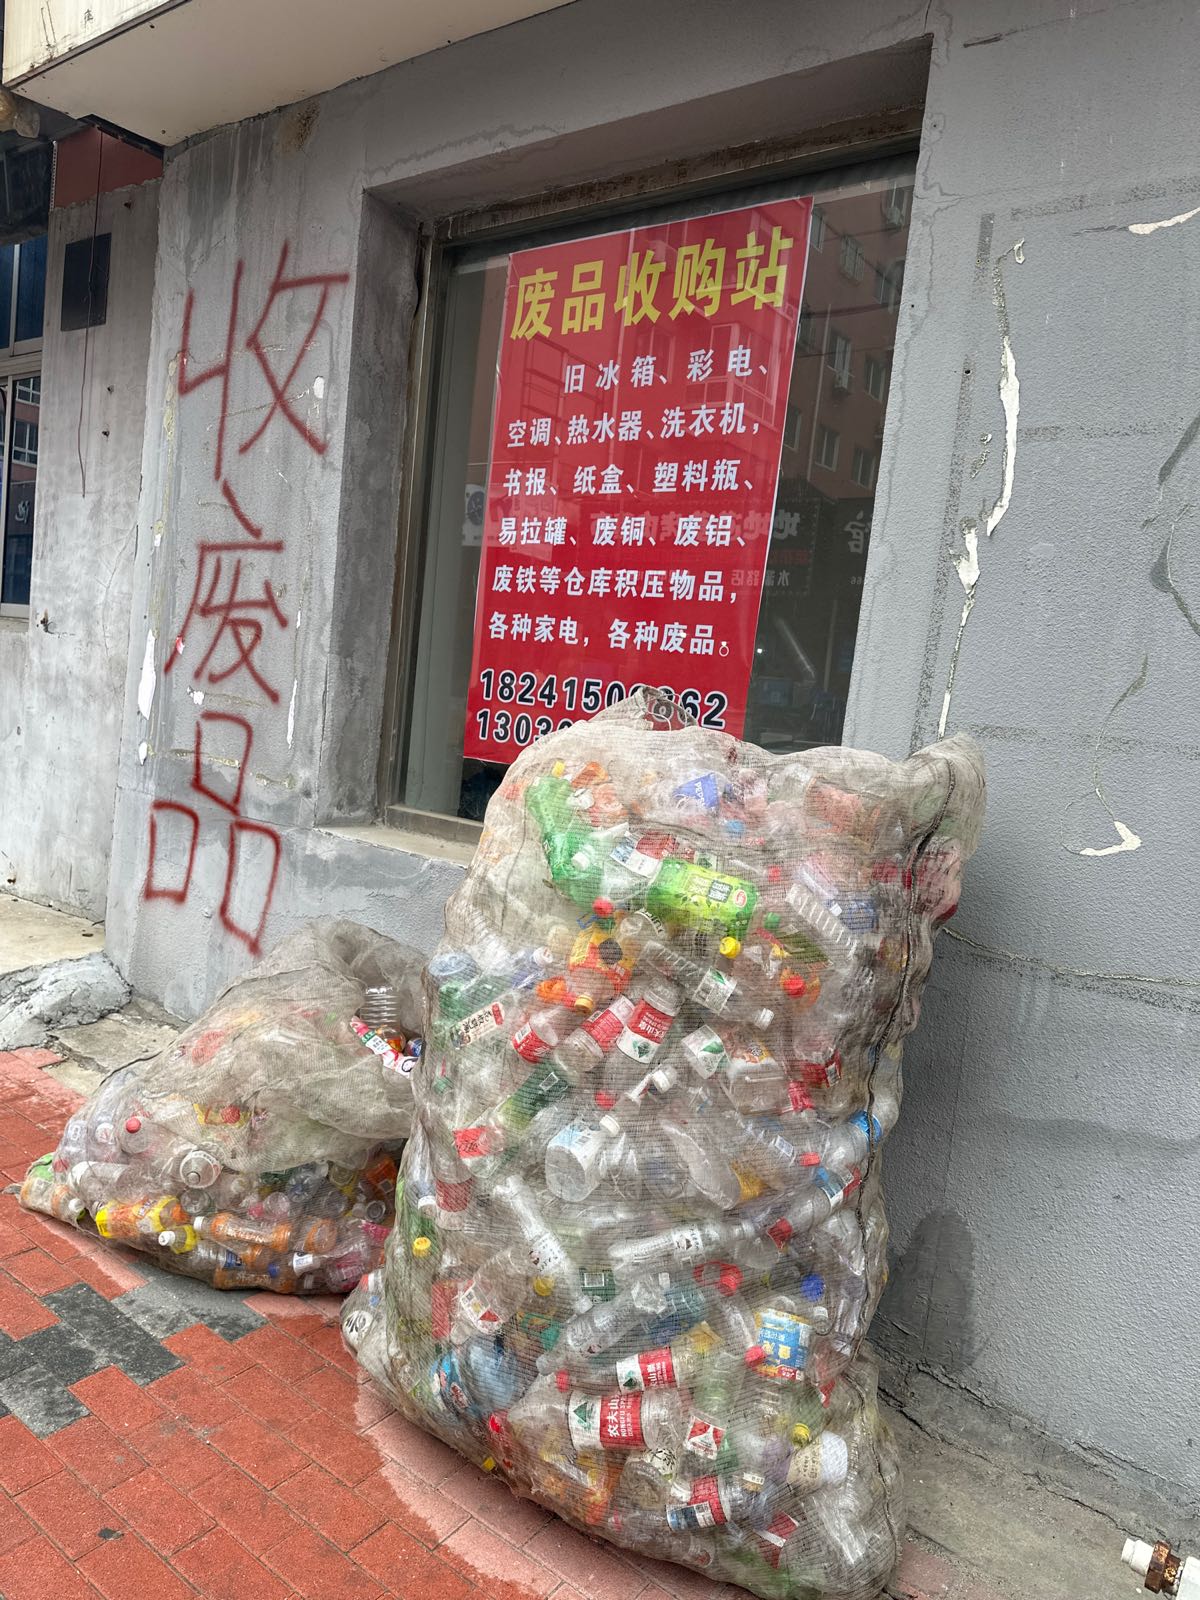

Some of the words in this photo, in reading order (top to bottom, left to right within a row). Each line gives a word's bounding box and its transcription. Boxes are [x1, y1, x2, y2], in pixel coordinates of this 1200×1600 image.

[510, 226, 793, 340] 废品收购站
[143, 240, 350, 957] 收废品
[477, 708, 574, 747] 1303
